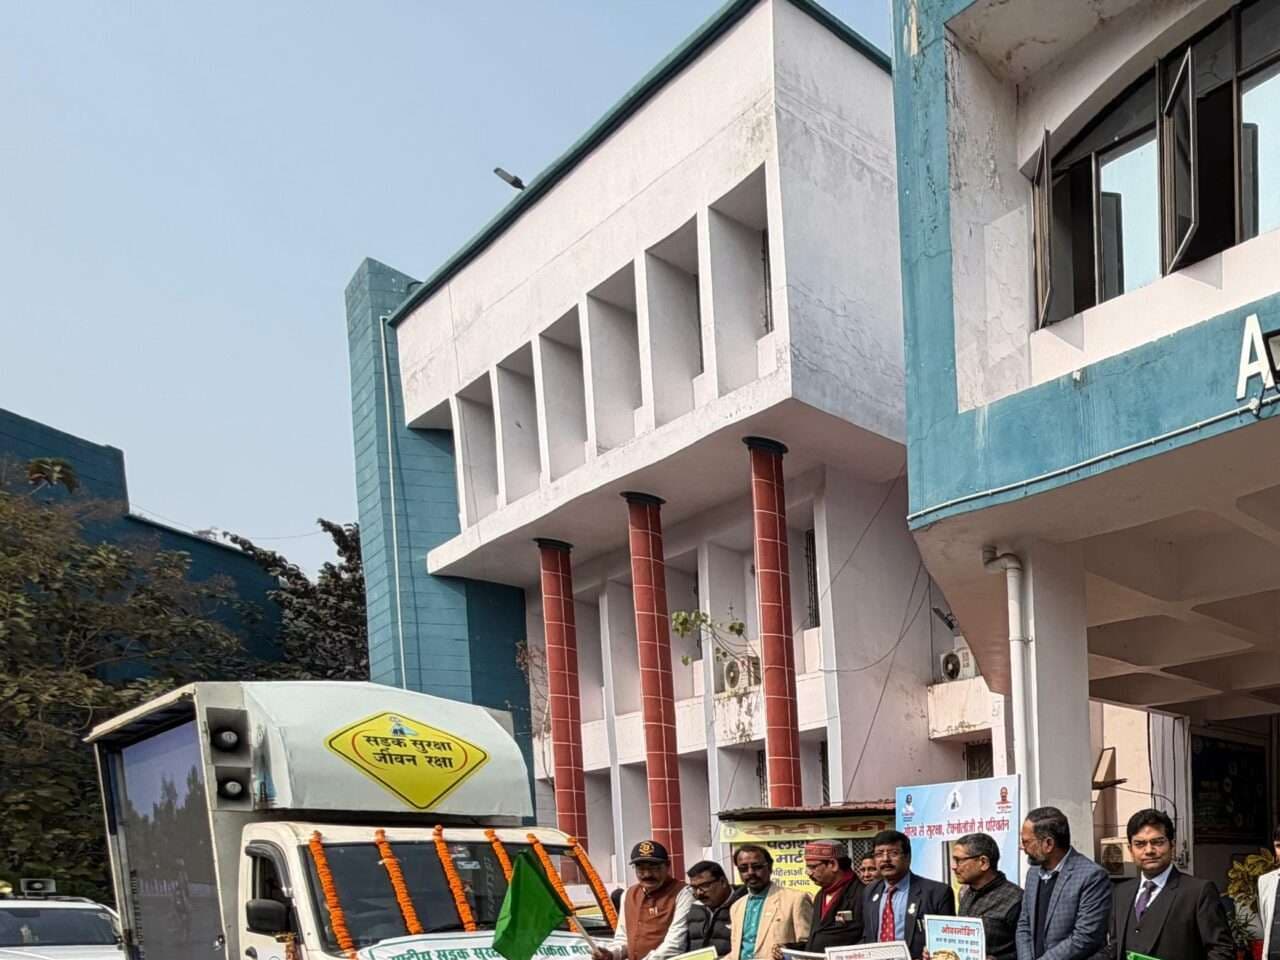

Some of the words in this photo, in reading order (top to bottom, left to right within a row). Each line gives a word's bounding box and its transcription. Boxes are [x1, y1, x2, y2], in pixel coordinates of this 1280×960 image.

[1236, 312, 1275, 400] A
[410, 738, 453, 754] सुरक्षा
[372, 748, 417, 767] जीवन
[425, 755, 454, 769] रक्षा
[743, 822, 824, 836] दीदी
[834, 820, 889, 833] की
